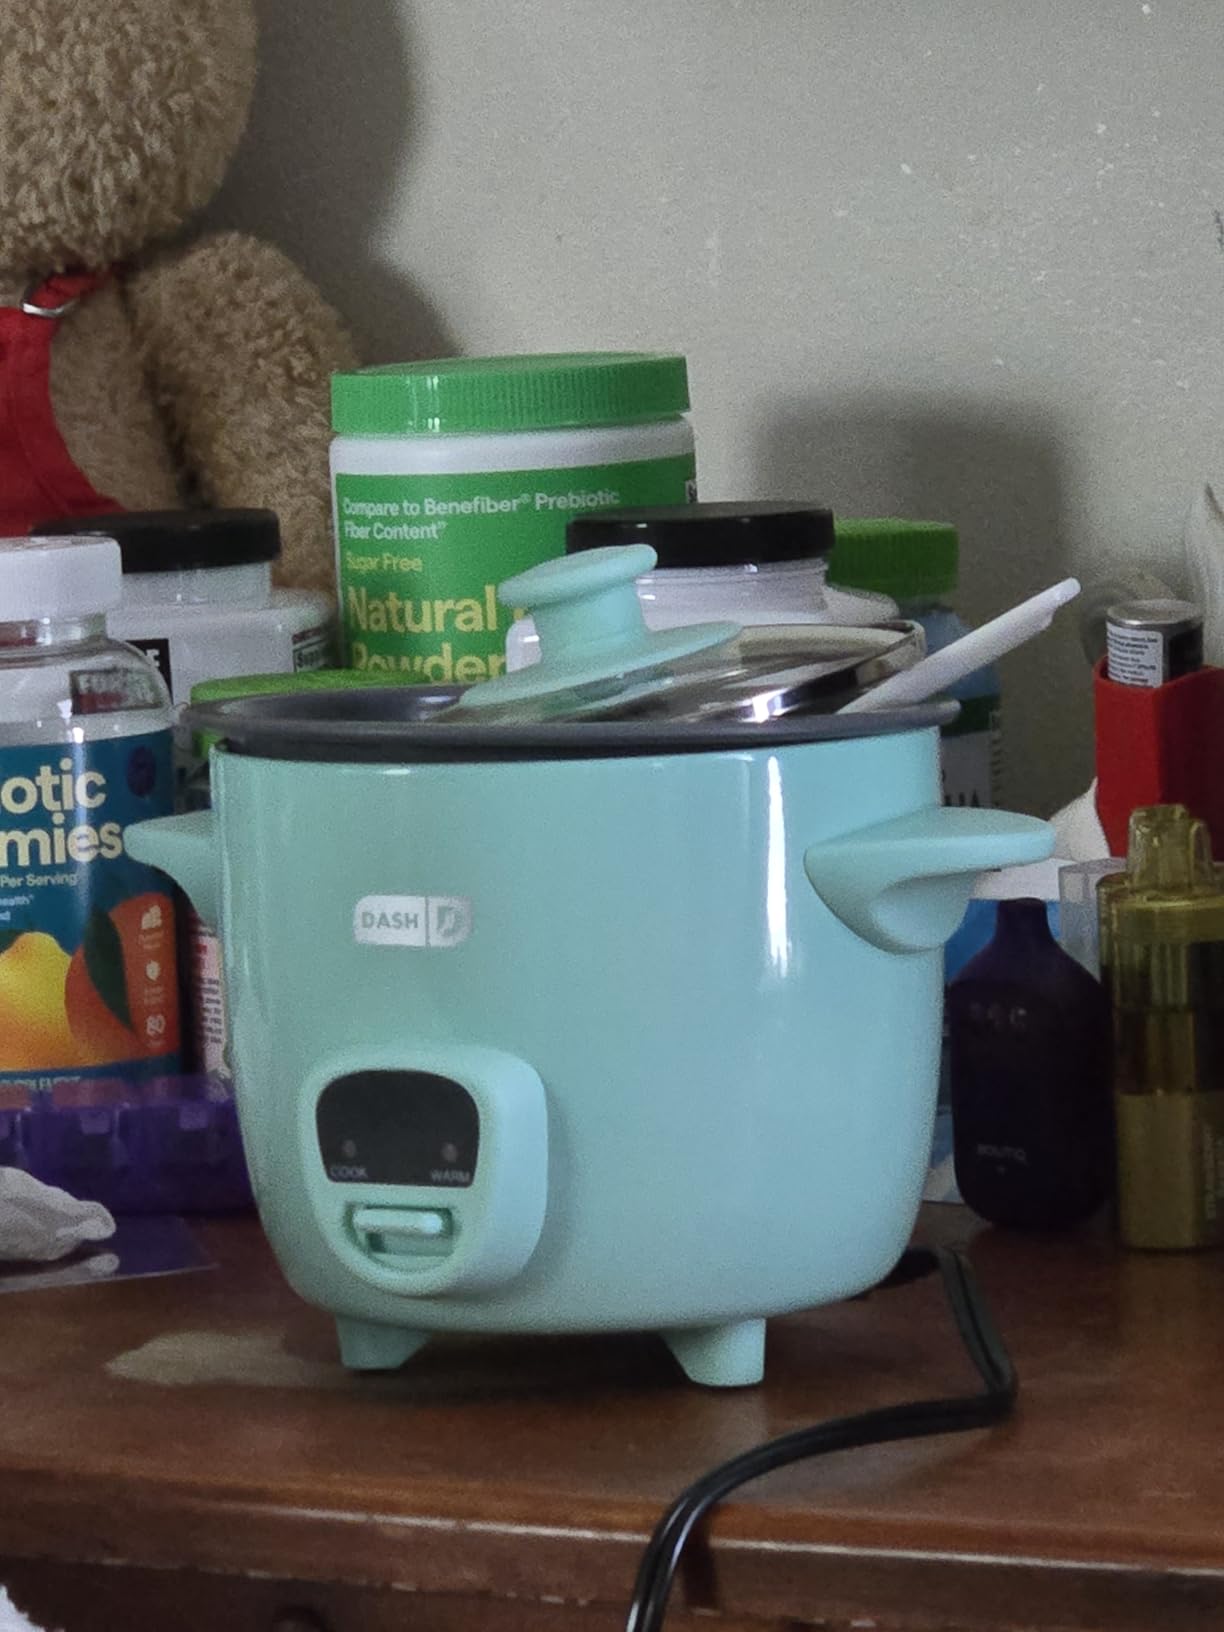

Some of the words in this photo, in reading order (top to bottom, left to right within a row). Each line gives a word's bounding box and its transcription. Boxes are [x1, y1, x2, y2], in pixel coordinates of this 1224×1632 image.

[342, 497, 400, 518] Compare
[402, 499, 421, 516] to
[535, 488, 621, 511] Prebiotic
[382, 552, 423, 572] Free
[348, 584, 498, 633] Natural
[0, 874, 24, 889] Per
[26, 872, 79, 888] Serving
[360, 911, 419, 930] DASH
[330, 1166, 368, 1179] COOK
[430, 1169, 471, 1184] WARM
